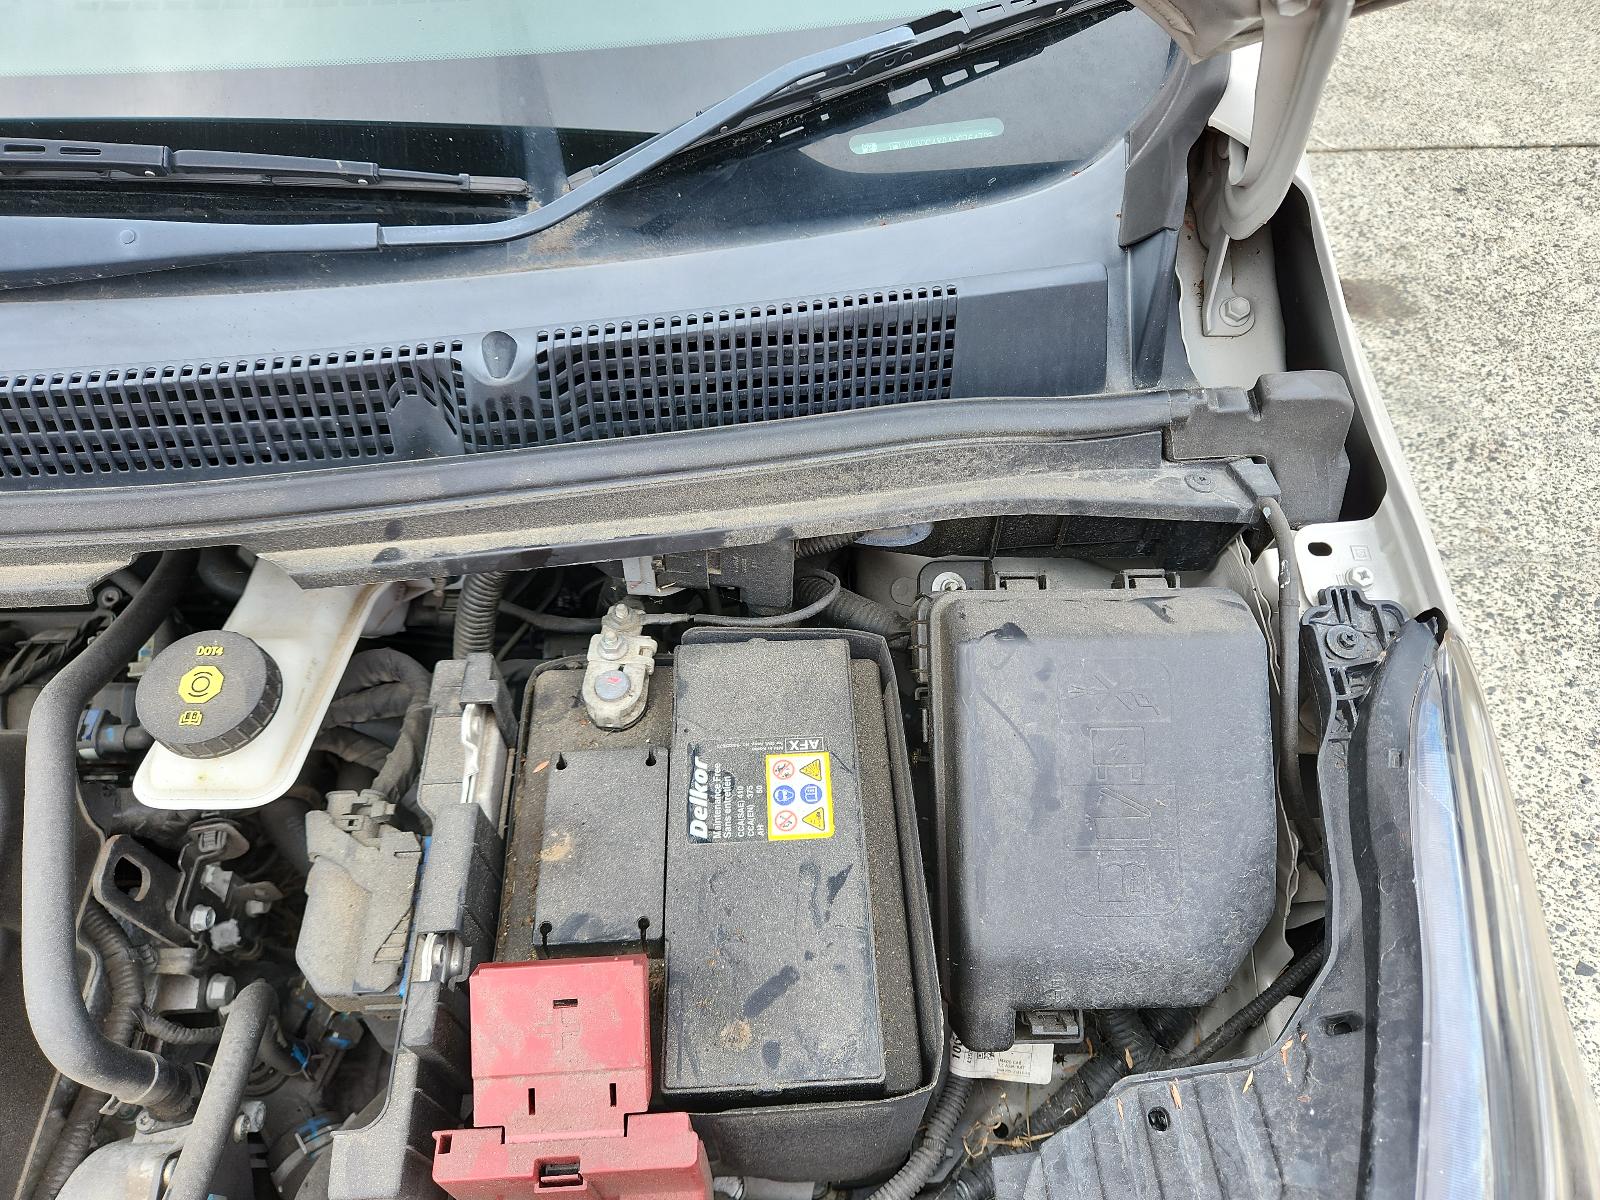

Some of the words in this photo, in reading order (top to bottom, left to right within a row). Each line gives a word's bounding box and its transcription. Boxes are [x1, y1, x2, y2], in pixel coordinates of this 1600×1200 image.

[196, 645, 224, 656] DOT4
[789, 740, 819, 751] AFX
[713, 763, 722, 782] Free
[689, 755, 708, 839] Delkor
[723, 775, 732, 814] entretien
[746, 785, 754, 799] 375
[713, 782, 722, 839] Maintenance
[737, 800, 746, 837] CCA(SAE)
[746, 804, 756, 837] CCA(EN)
[723, 815, 732, 839] Sans
[757, 823, 765, 837] AH
